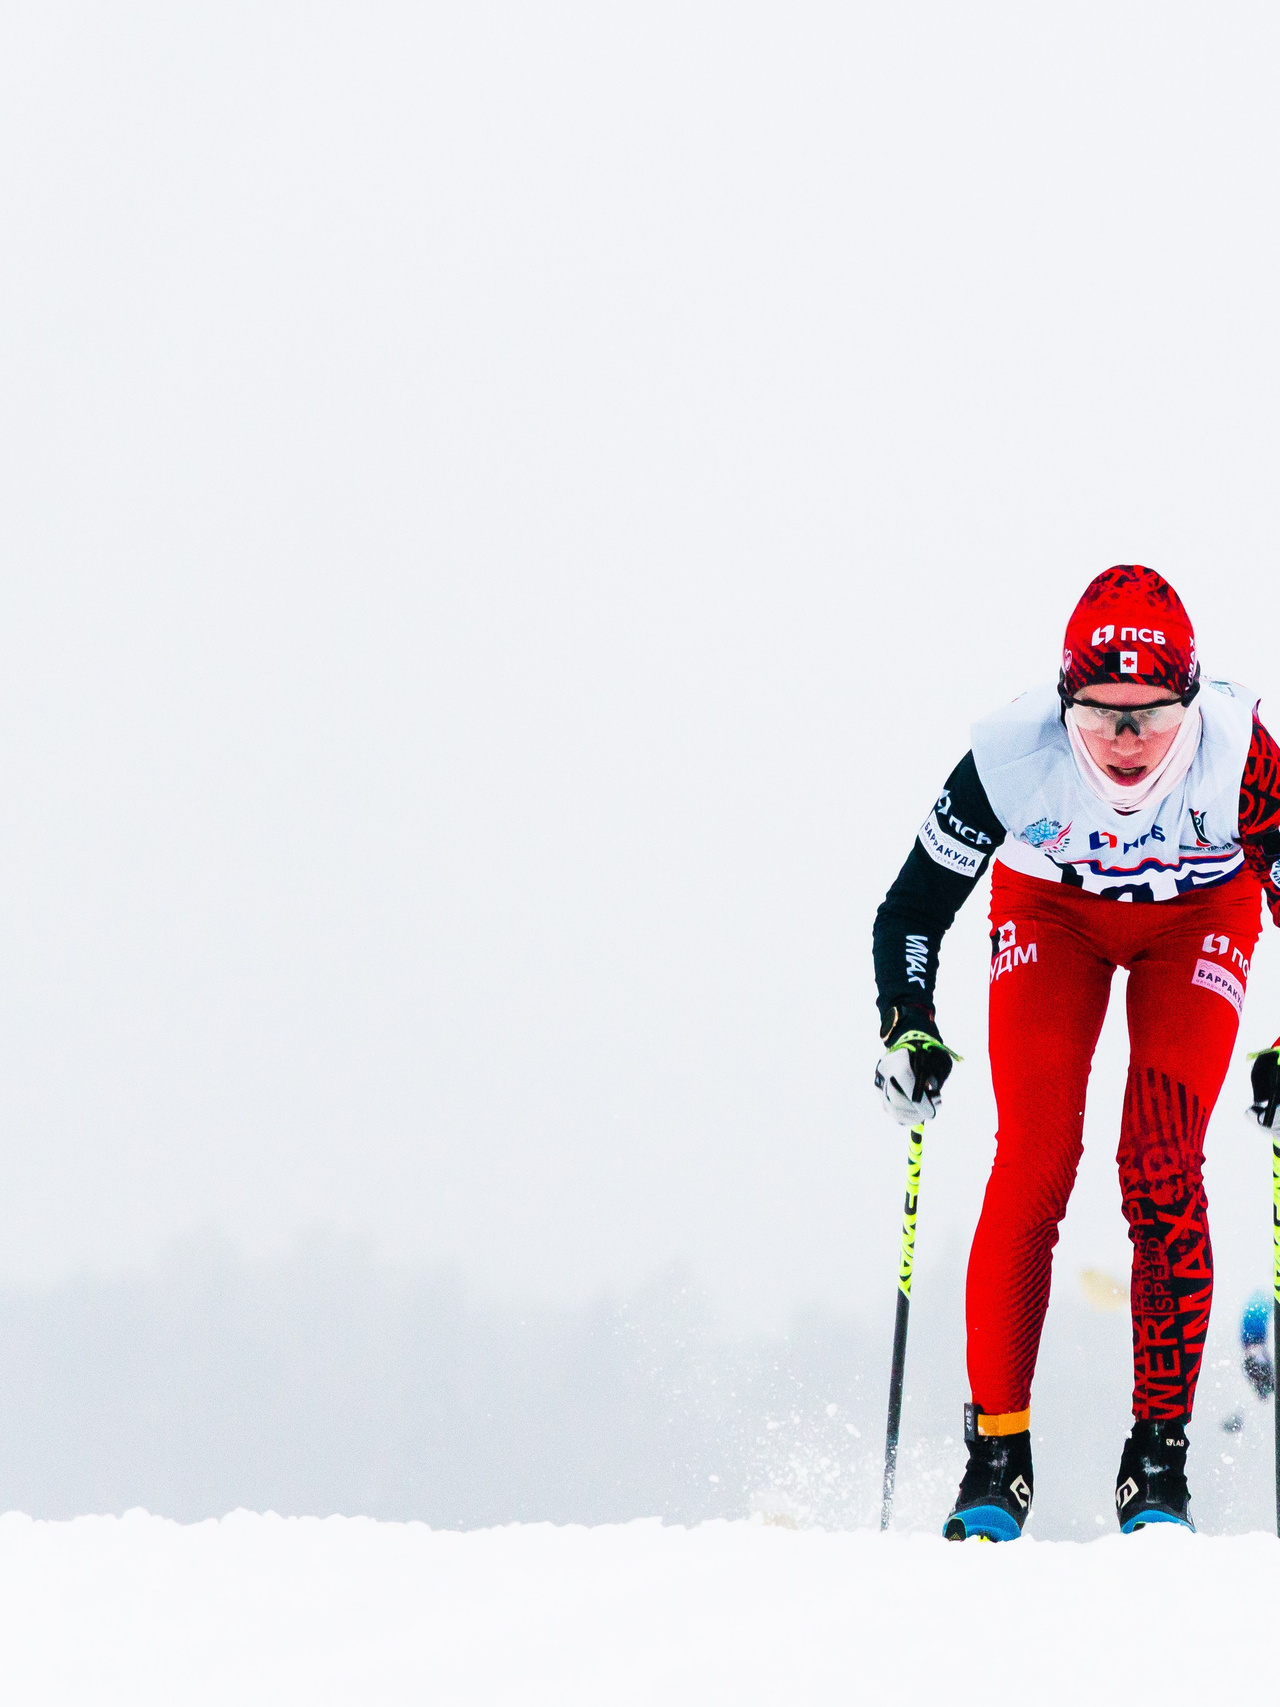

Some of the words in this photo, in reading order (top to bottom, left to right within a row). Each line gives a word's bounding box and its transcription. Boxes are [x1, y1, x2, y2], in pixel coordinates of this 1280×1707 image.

[1120, 627, 1166, 645] ПСБ
[924, 822, 976, 868] БАРРАКУДА
[1146, 1237, 1175, 1312] SPEED
